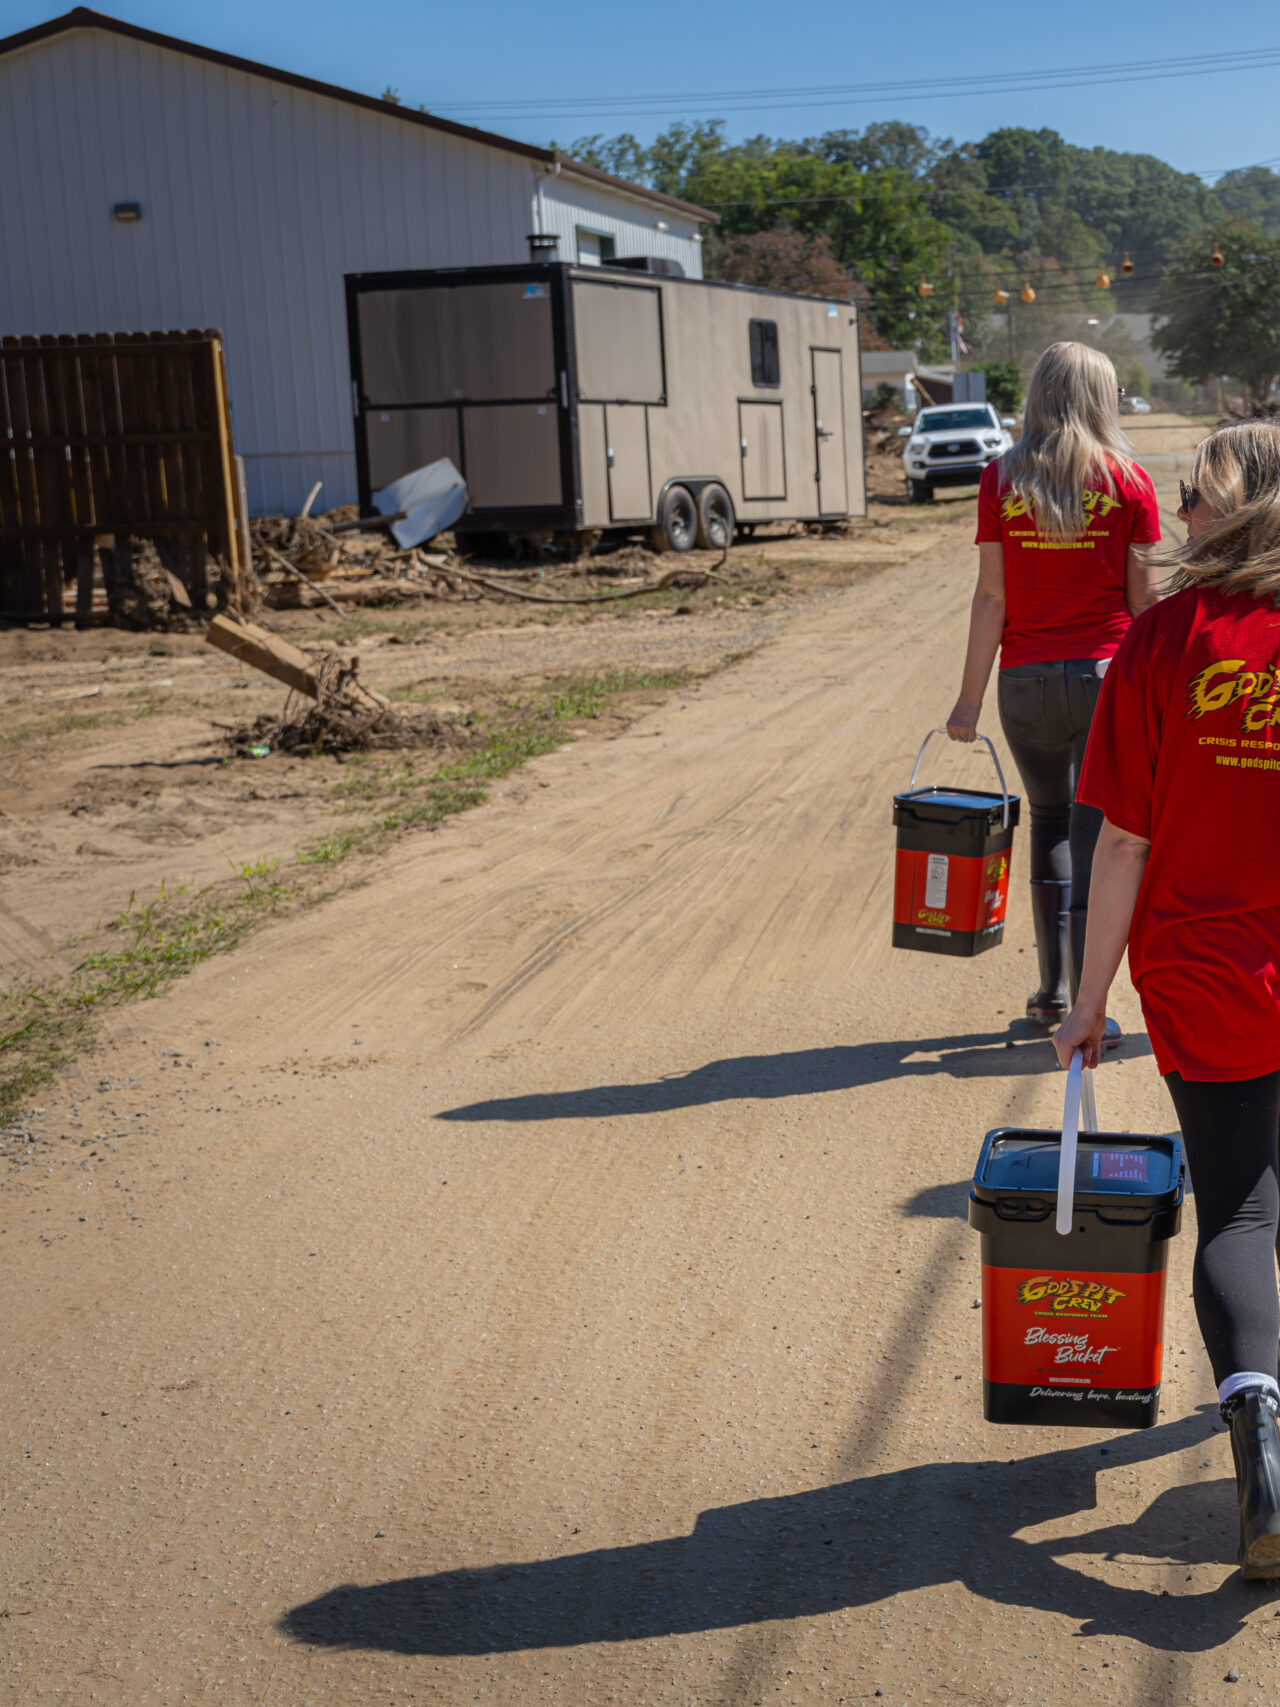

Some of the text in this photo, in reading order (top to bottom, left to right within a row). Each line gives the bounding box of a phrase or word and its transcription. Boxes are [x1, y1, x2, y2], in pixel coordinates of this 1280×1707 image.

[1198, 736, 1237, 747] CRISIS
[1082, 1281, 1128, 1305] PIT
[1049, 1296, 1102, 1313] CREW
[1024, 1326, 1089, 1351] Blessing
[1054, 1345, 1118, 1365] Bucket
[1029, 1386, 1084, 1401] Delivering
